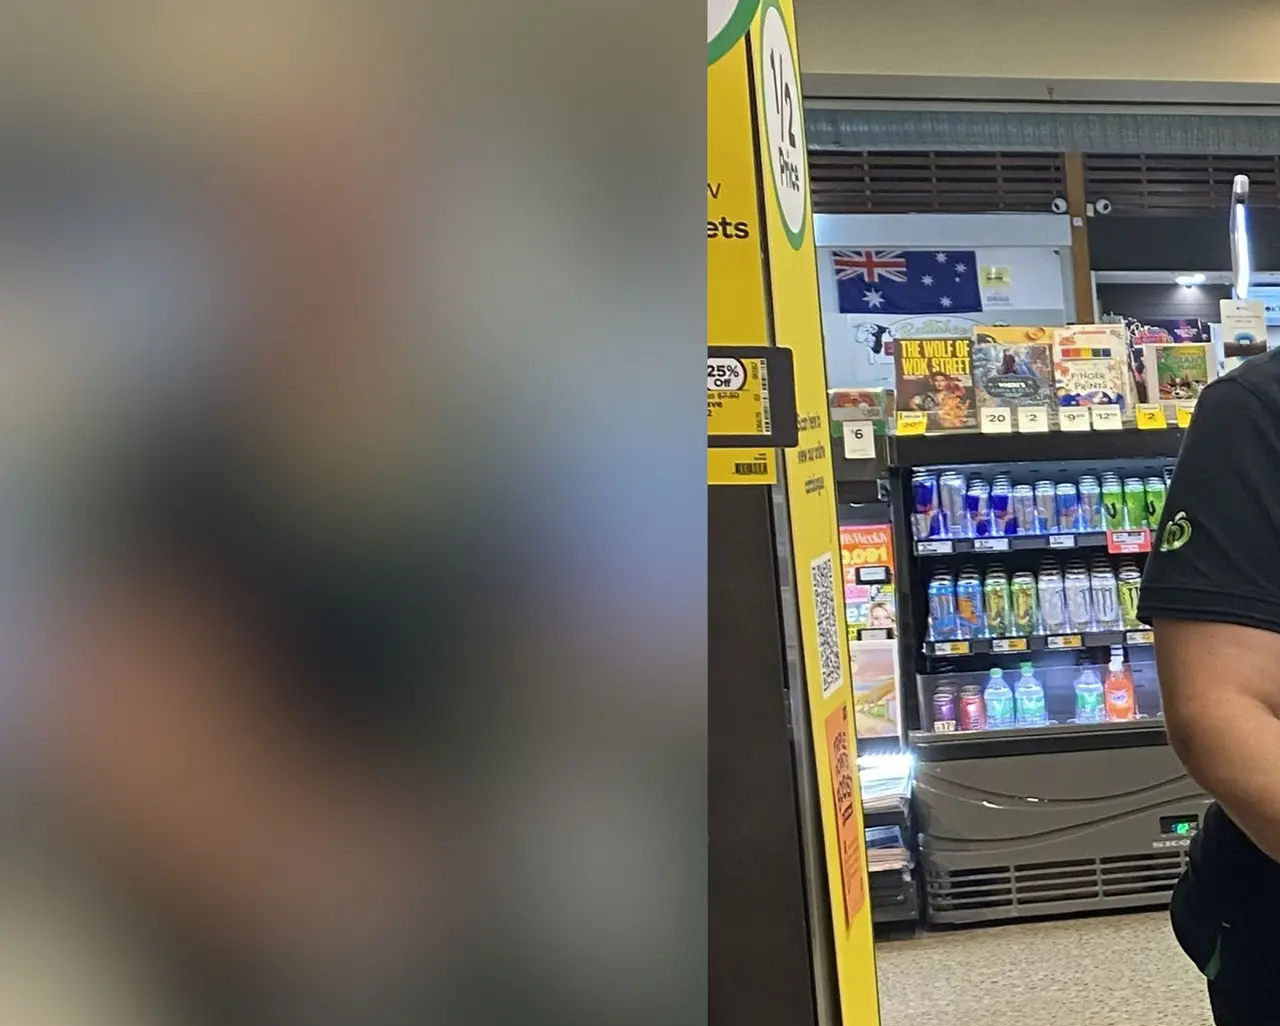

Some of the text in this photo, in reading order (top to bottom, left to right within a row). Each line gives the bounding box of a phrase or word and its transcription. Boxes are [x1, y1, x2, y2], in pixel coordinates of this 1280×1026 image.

[900, 341, 970, 357] THE WOLF OF
[707, 365, 740, 377] 25%
[902, 358, 970, 375] WOK STREET
[1071, 372, 1106, 380] FINGER
[714, 379, 732, 387] Off
[1075, 382, 1107, 390] PRINTS
